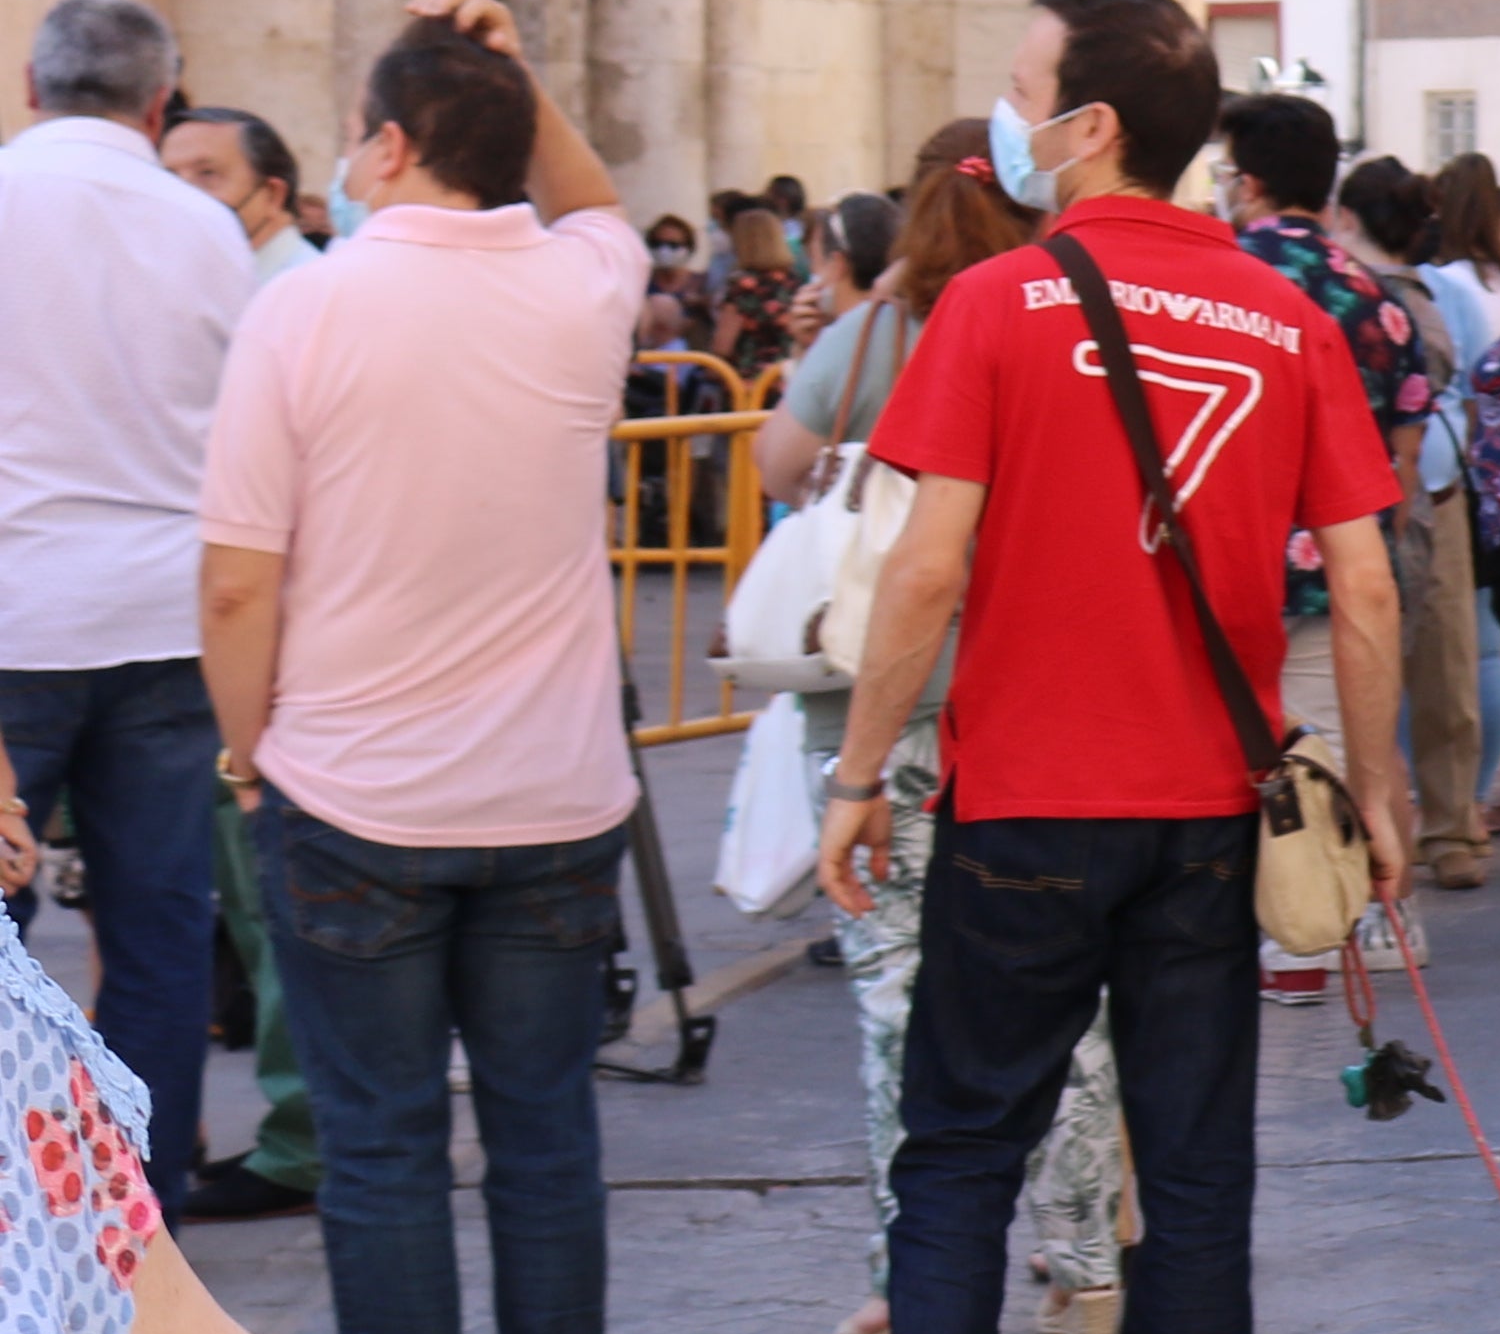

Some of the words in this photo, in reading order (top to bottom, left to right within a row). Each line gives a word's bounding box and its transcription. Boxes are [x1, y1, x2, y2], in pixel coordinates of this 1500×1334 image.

[1021, 277, 1161, 316] EMRIO
[1195, 295, 1302, 354] ARMANI
[1072, 339, 1264, 555] 7
